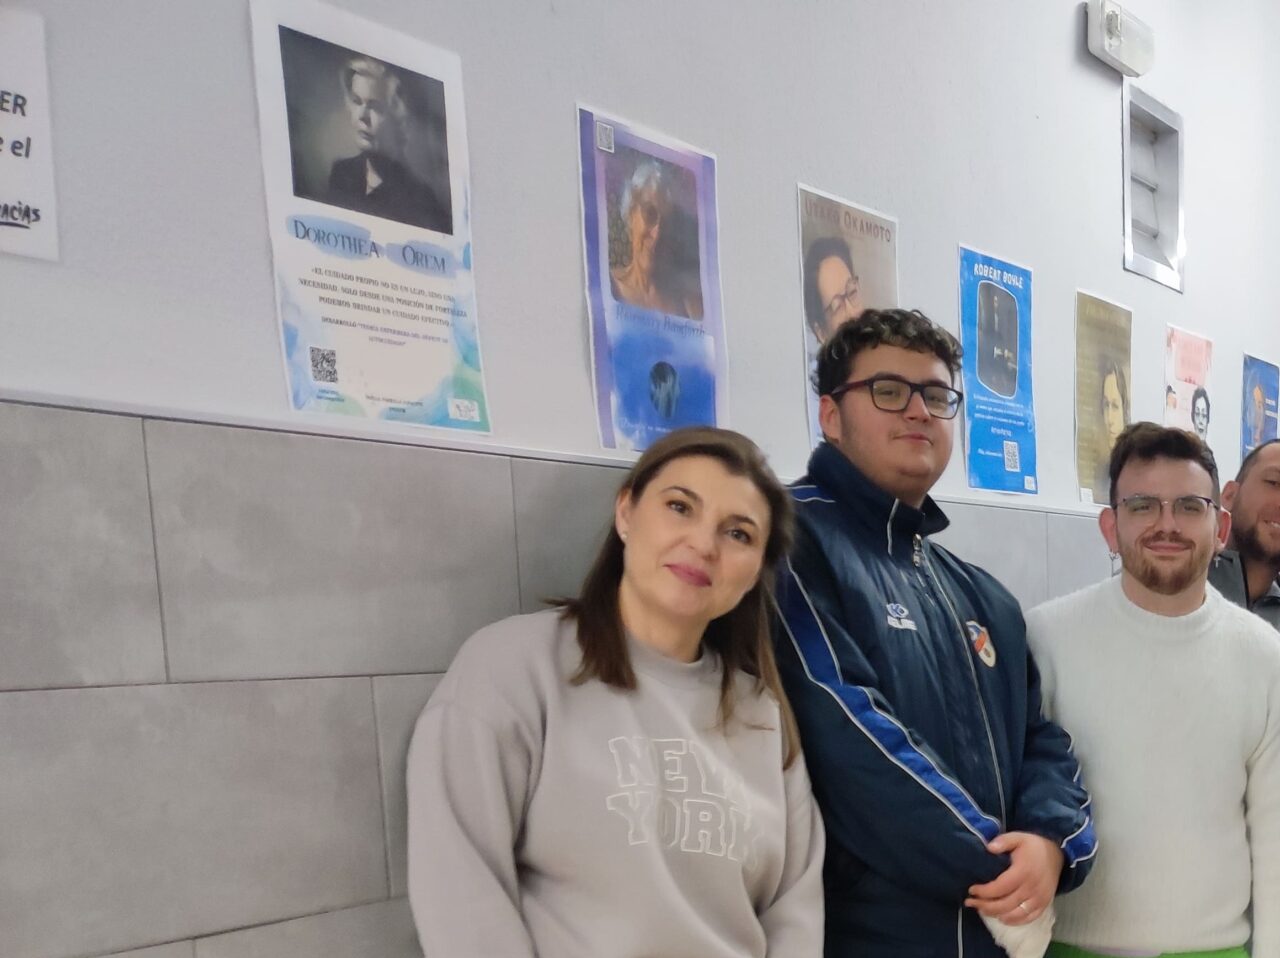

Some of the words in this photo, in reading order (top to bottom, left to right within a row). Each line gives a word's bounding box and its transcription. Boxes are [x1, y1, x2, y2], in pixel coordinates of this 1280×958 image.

[11, 136, 32, 160] el
[844, 211, 891, 242] OKAMOTO
[973, 263, 1002, 281] ROBERT
[1002, 271, 1024, 289] BOYLE
